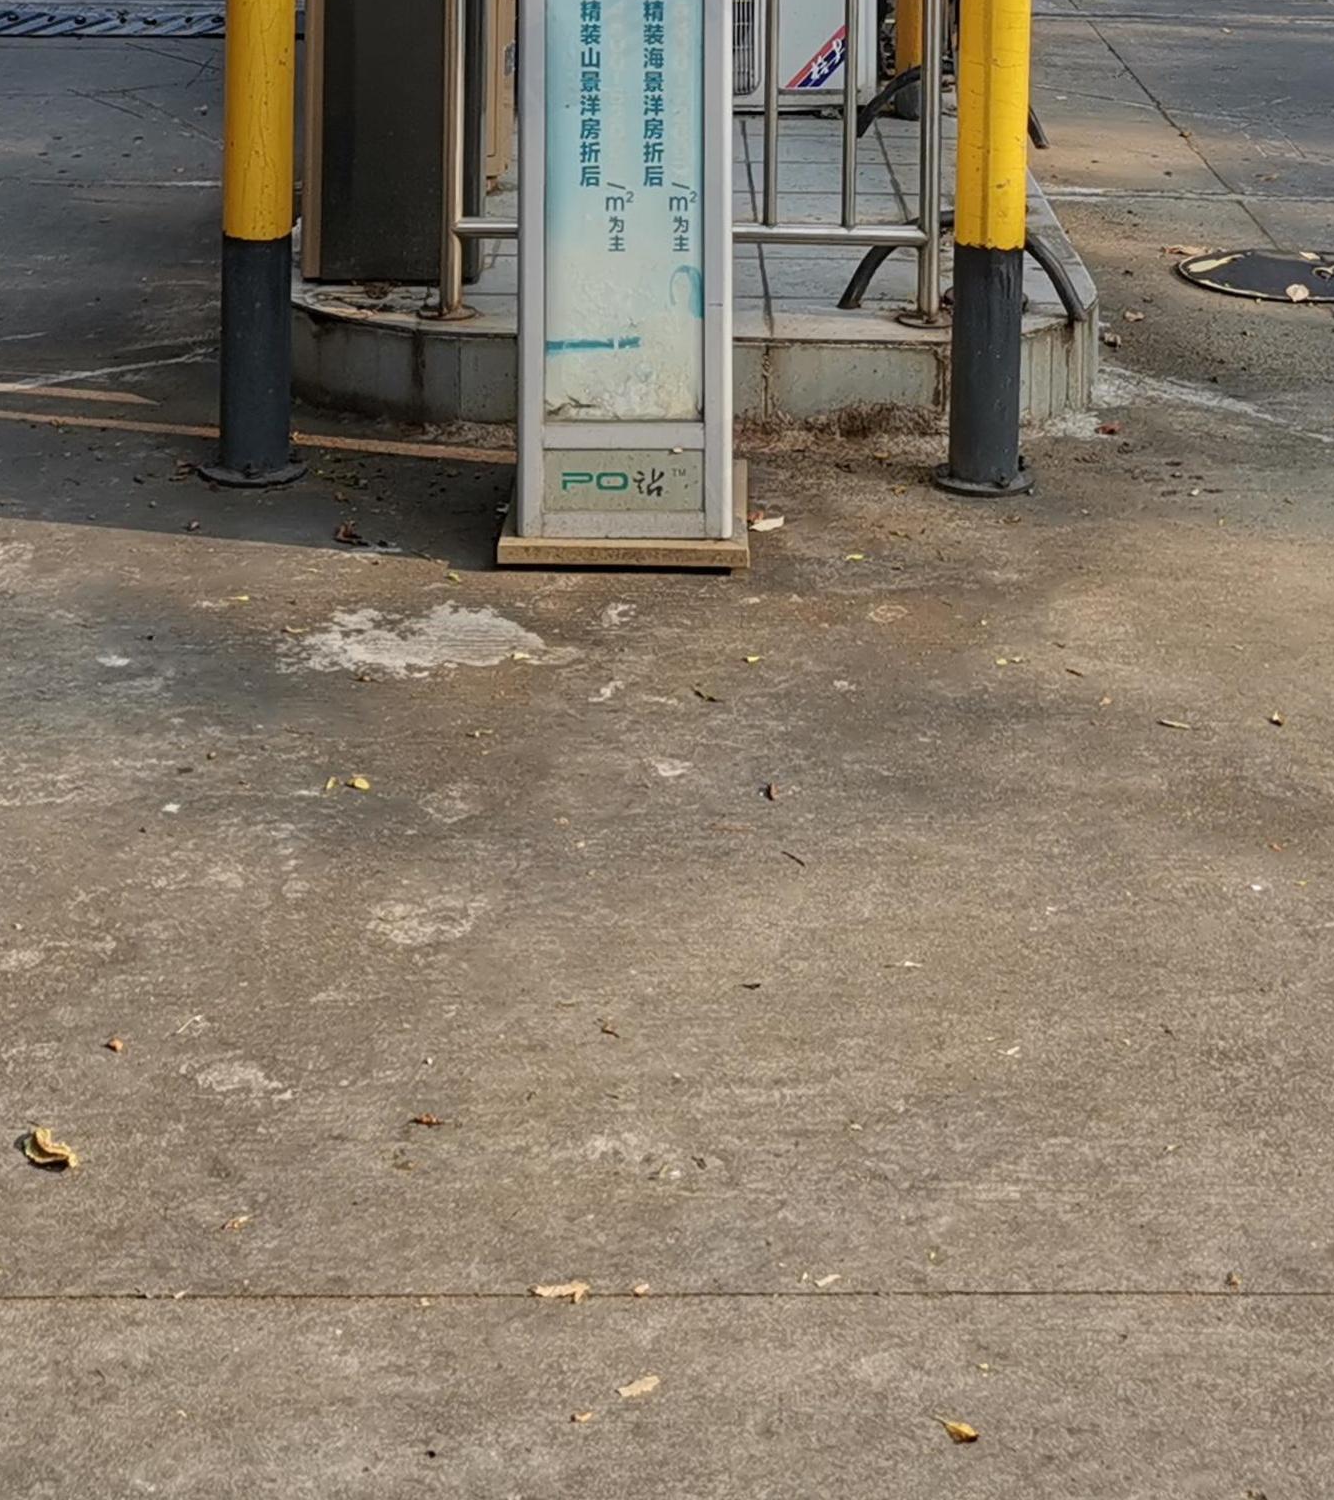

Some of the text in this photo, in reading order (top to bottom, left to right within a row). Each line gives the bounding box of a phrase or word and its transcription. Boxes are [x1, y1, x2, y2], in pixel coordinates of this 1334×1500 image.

[579, 0, 601, 187] 精装山景洋房折后
[642, 0, 664, 187] 精装海景洋房折后
